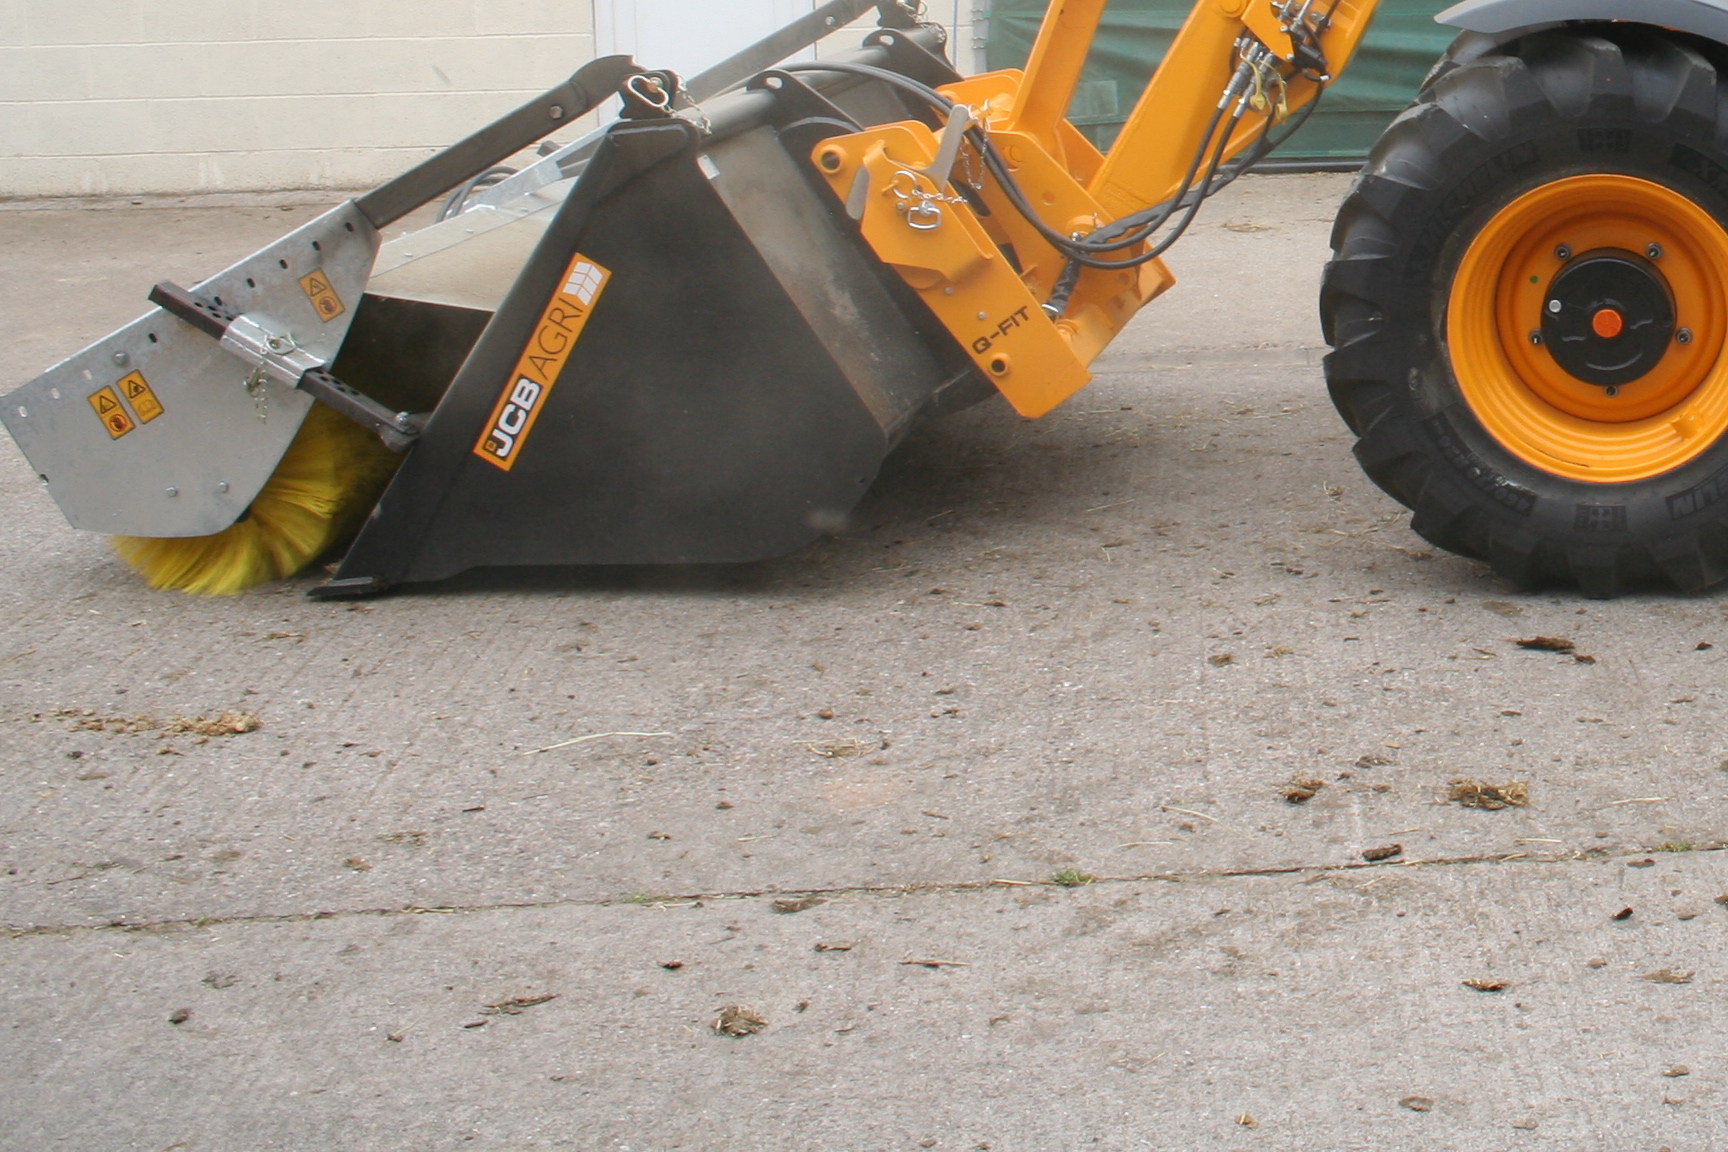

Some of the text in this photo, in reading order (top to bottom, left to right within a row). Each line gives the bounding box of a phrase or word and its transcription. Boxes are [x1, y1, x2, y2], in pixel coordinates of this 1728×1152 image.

[492, 296, 585, 458] JCB AGRI
[972, 304, 1030, 355] Q-FIT
